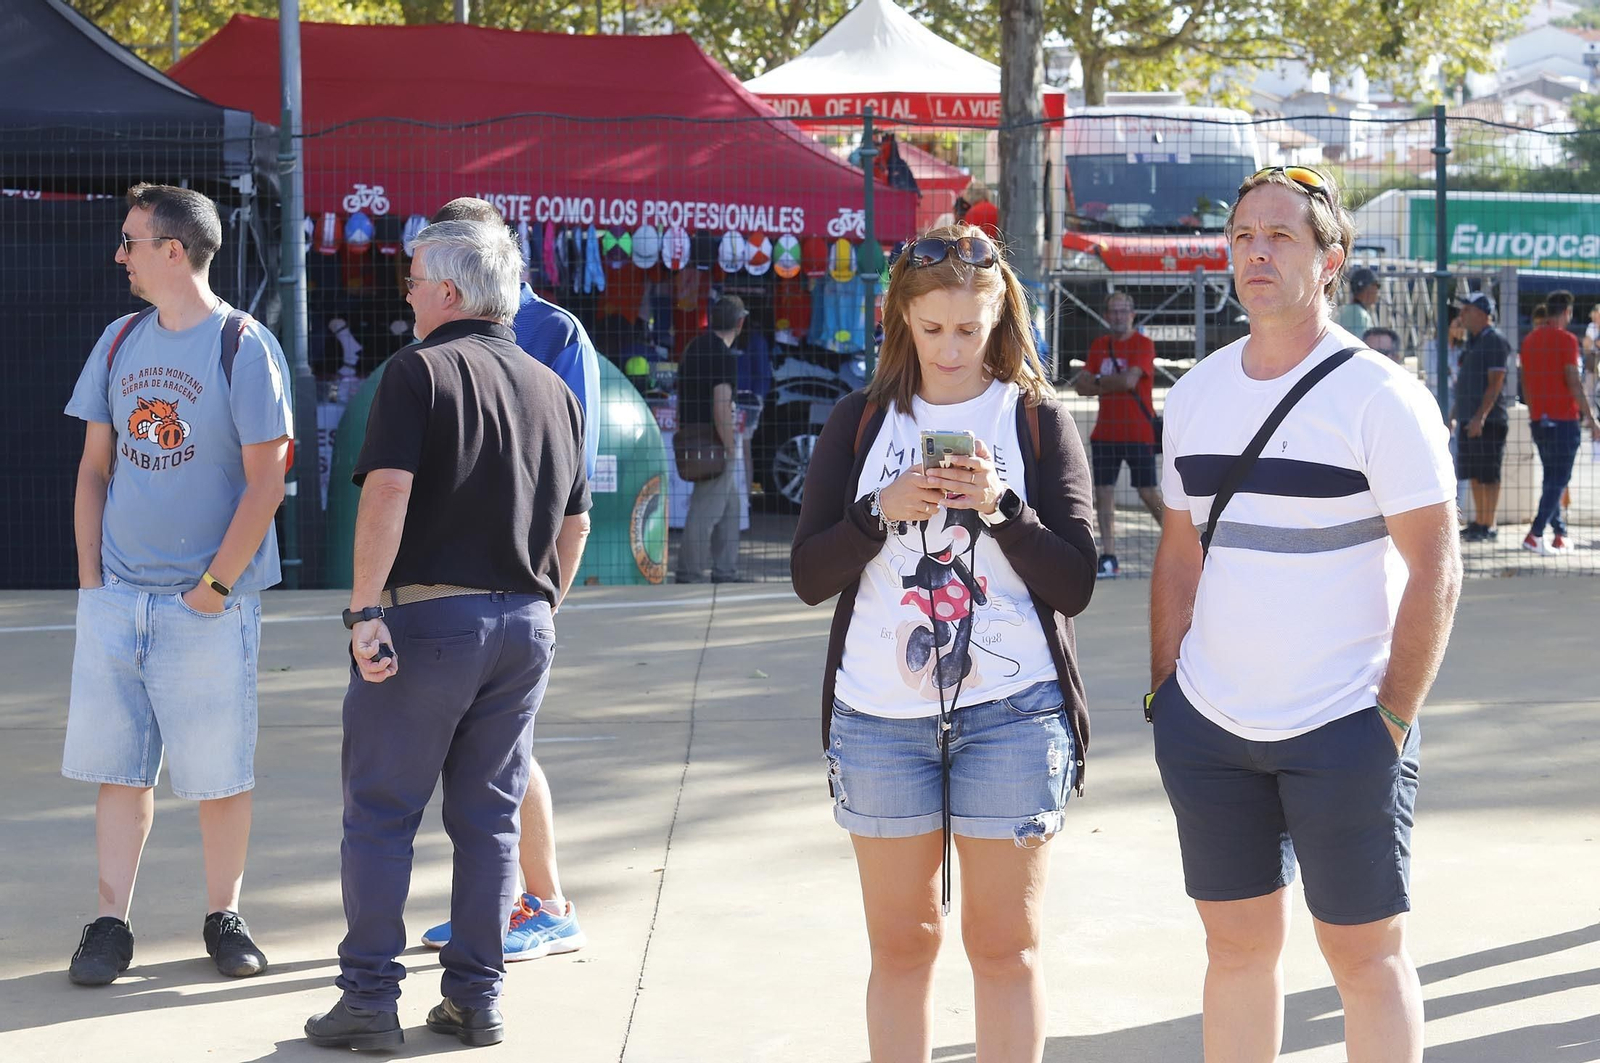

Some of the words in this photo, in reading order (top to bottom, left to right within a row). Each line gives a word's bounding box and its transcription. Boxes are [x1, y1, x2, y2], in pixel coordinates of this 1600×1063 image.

[763, 98, 813, 117] NDA
[824, 97, 918, 119] OFICIAL
[968, 99, 1001, 118] VUE
[535, 196, 595, 225] COMO
[600, 198, 637, 226] LOS
[642, 200, 805, 234] PROFESIONALES
[1451, 223, 1600, 267] Europca
[122, 380, 149, 398] SIERRA
[151, 379, 161, 388] DE
[163, 380, 198, 404] ARACENA
[138, 367, 164, 378] ARIAS
[165, 367, 204, 394] MONTANO
[121, 443, 195, 471] JABATOS
[981, 633, 1002, 646] 1928
